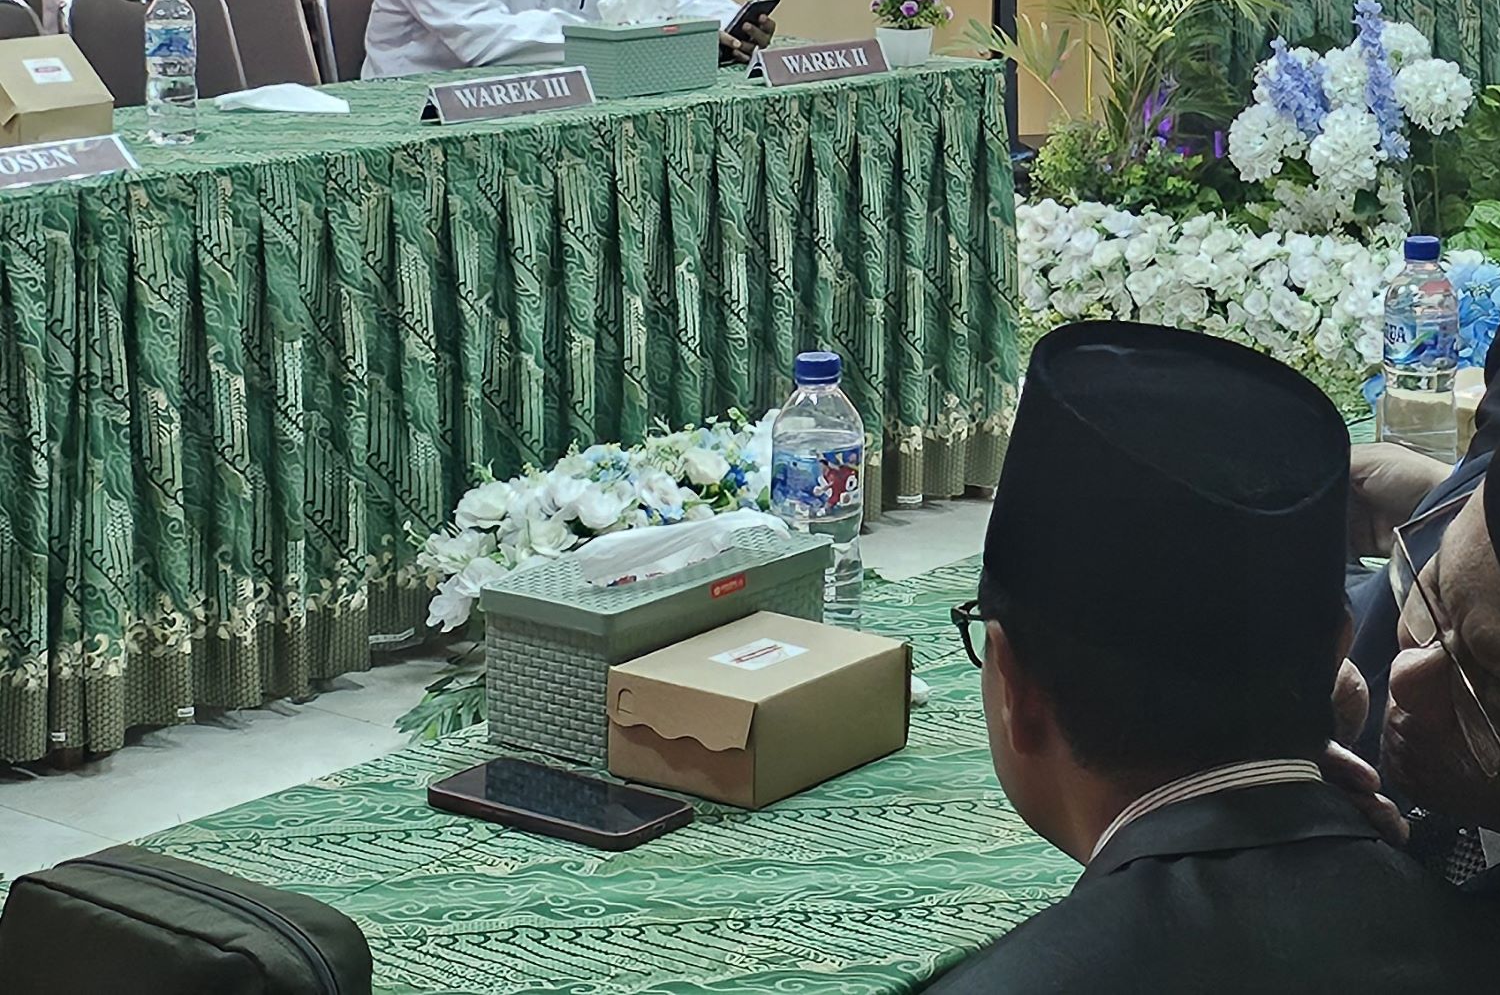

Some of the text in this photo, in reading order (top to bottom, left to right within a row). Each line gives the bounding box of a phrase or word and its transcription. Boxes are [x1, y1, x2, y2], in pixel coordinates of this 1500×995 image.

[782, 47, 868, 74] WAREK II
[454, 75, 571, 108] WAREK III
[0, 148, 79, 175] OSEN
